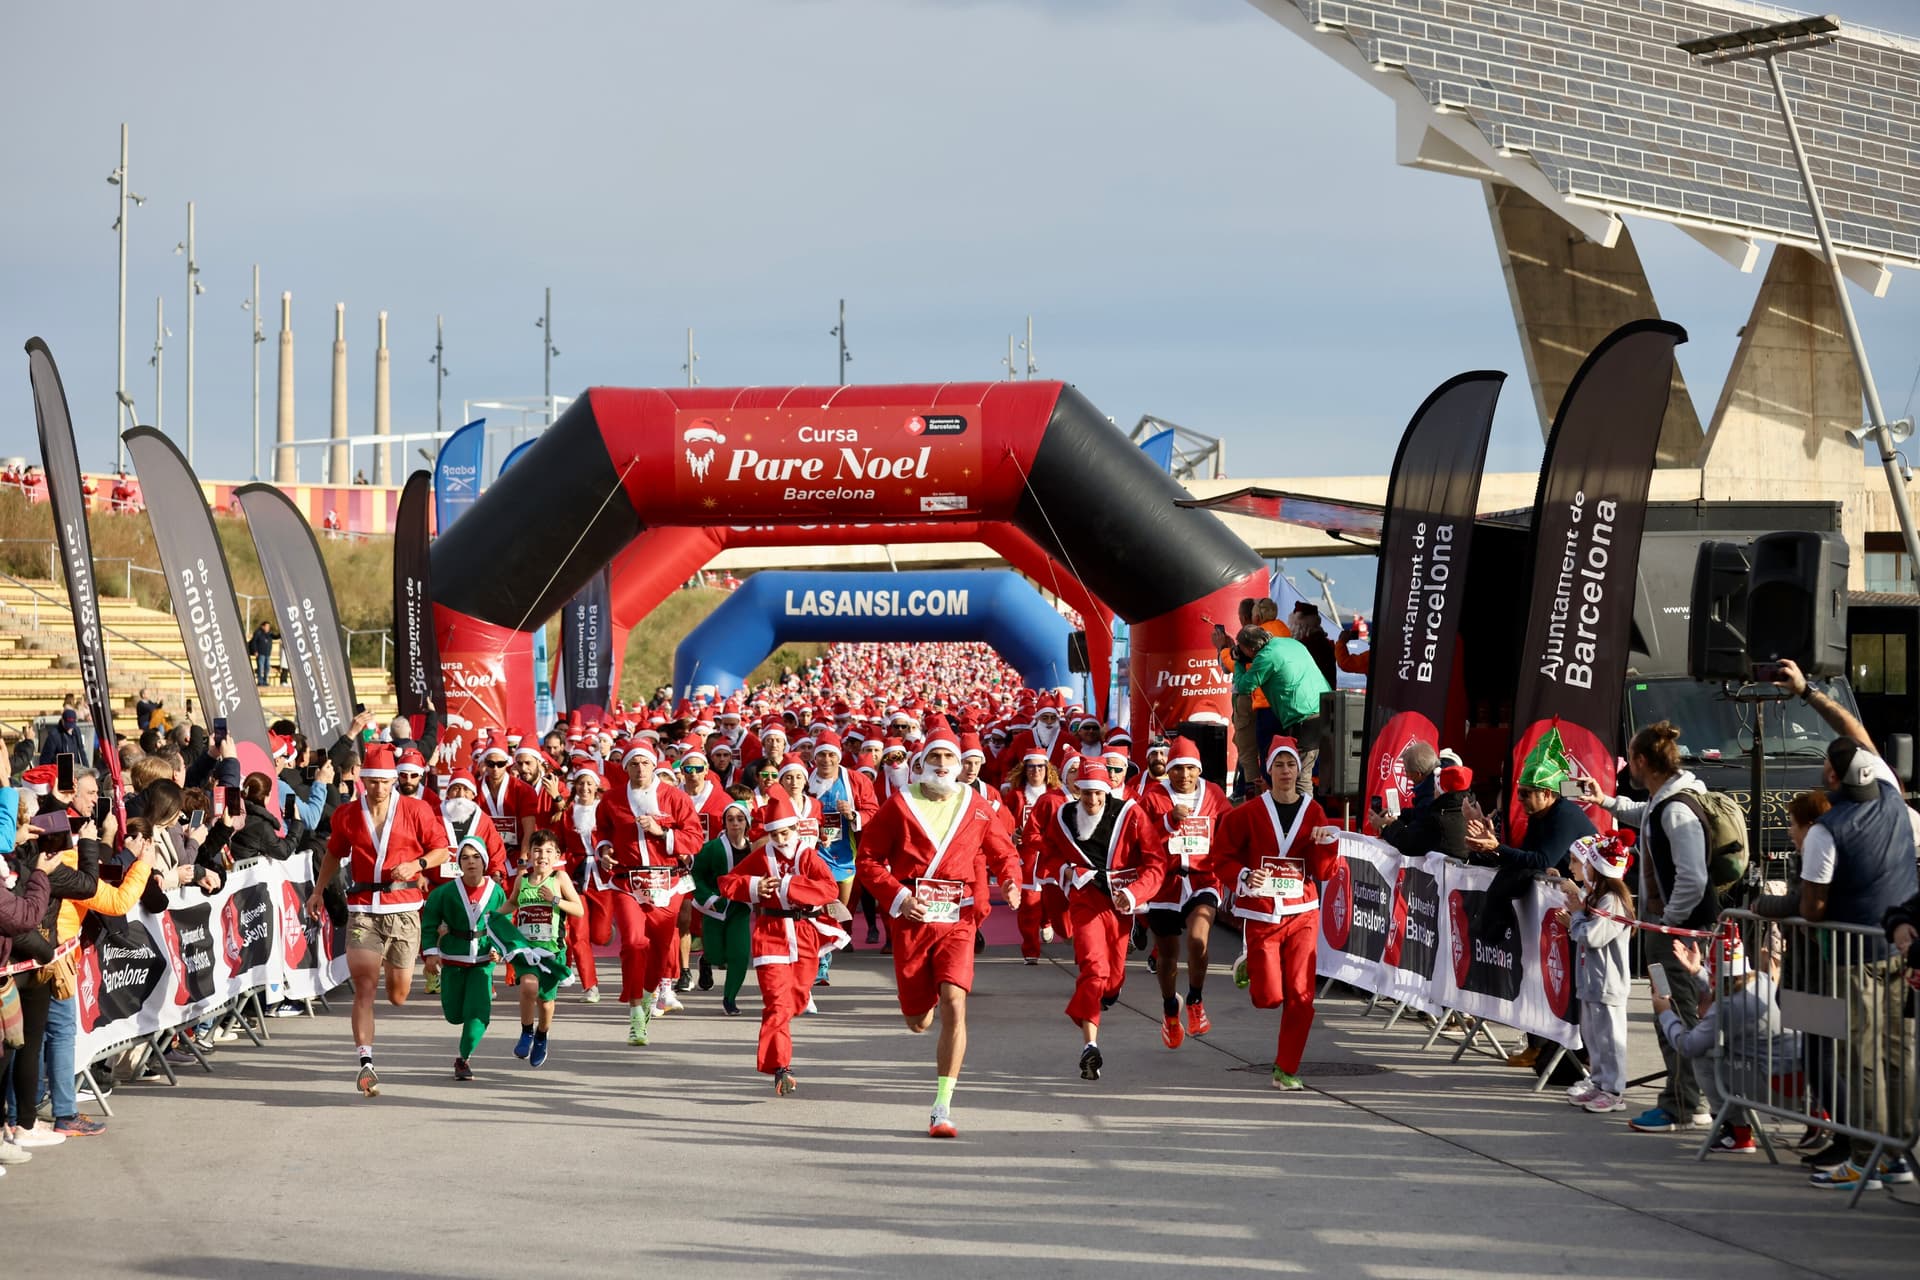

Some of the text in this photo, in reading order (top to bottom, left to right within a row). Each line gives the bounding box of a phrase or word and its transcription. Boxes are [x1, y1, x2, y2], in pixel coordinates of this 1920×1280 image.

[798, 426, 858, 443] Cursa
[725, 446, 932, 481] Pare Noel
[783, 487, 875, 501] Barcelona
[1540, 490, 1585, 681] Ajuntament de
[1564, 499, 1617, 689] Barcelona
[785, 590, 969, 616] LASANSI.COM
[1398, 522, 1427, 680] Ajuntament de
[1417, 524, 1454, 683] Barcelona
[576, 604, 586, 621] de
[584, 604, 599, 689] Barcelona
[440, 661, 463, 670] ursa
[1188, 658, 1218, 668] Cursa
[450, 671, 497, 688] Noel
[1156, 667, 1233, 688] Pare No
[444, 689, 472, 698] elona
[1182, 686, 1228, 697] Barcelona
[1271, 878, 1295, 889] 1393
[1380, 888, 1387, 905] de
[927, 902, 951, 913] 2379
[1353, 904, 1386, 934] Barcelona
[529, 924, 541, 934] 13
[1504, 927, 1512, 940] e
[102, 963, 150, 993] Barcelona
